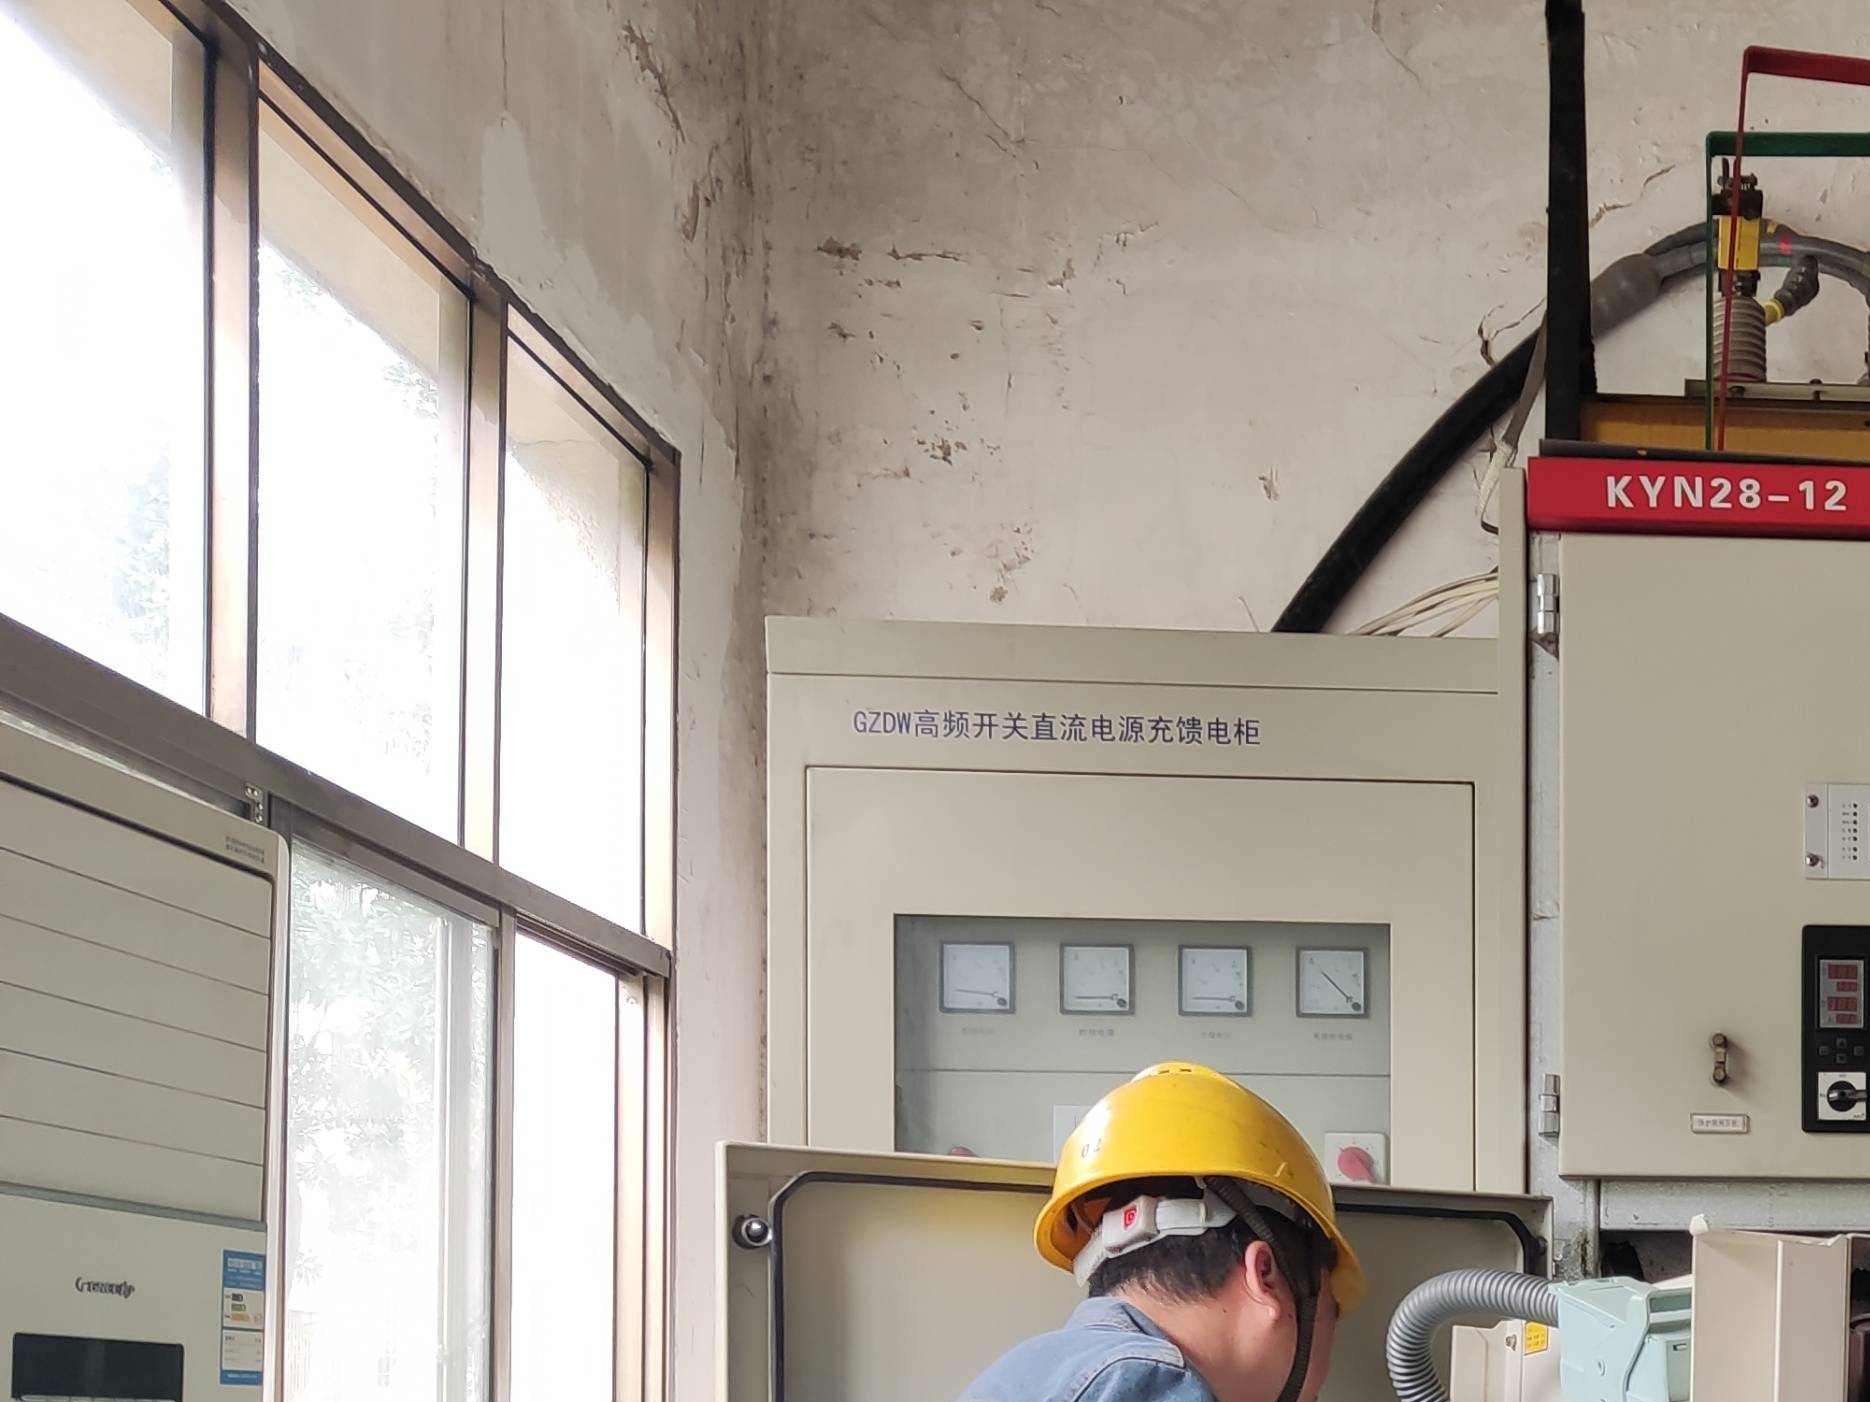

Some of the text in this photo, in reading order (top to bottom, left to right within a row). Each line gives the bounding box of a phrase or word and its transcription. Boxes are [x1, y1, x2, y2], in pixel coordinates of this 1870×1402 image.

[1606, 475, 1847, 511] KYN28-12
[853, 710, 1261, 746] GZDW高频开关直流电源充馈电柜
